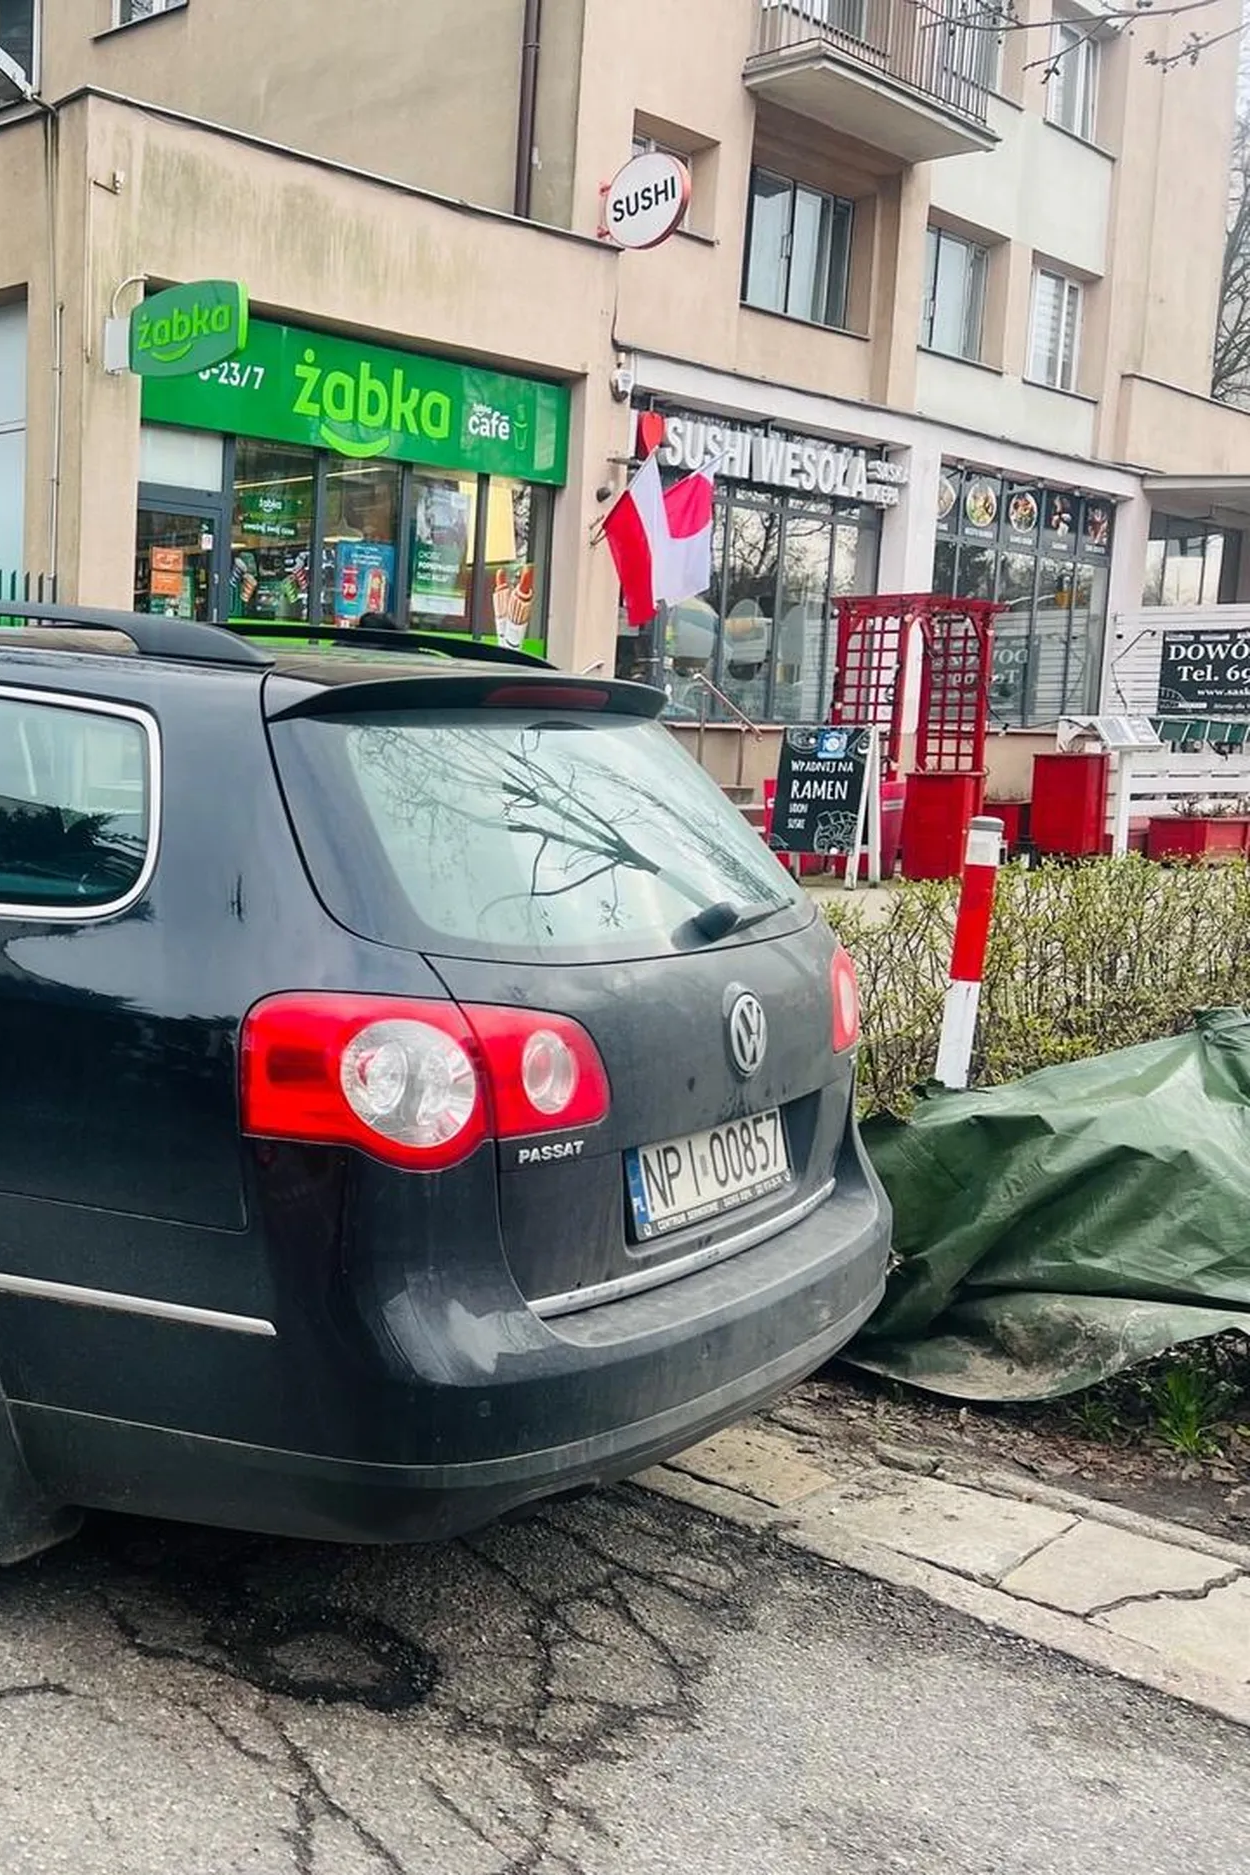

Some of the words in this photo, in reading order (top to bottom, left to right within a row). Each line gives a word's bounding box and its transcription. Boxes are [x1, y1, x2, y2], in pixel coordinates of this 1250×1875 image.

[611, 176, 679, 223] SUSHI
[138, 302, 232, 351] żabka
[294, 348, 451, 440] żabka
[660, 416, 750, 479] SUSHI
[753, 436, 867, 499] WESOŁA
[1168, 638, 1250, 660] DOWÓ
[1177, 664, 1220, 682] Tel.
[791, 760, 836, 773] WPADNIJ
[838, 761, 854, 772] NA
[790, 779, 849, 800] RAMEN
[518, 1140, 584, 1164] PASSAT
[709, 1110, 779, 1188] 00857
